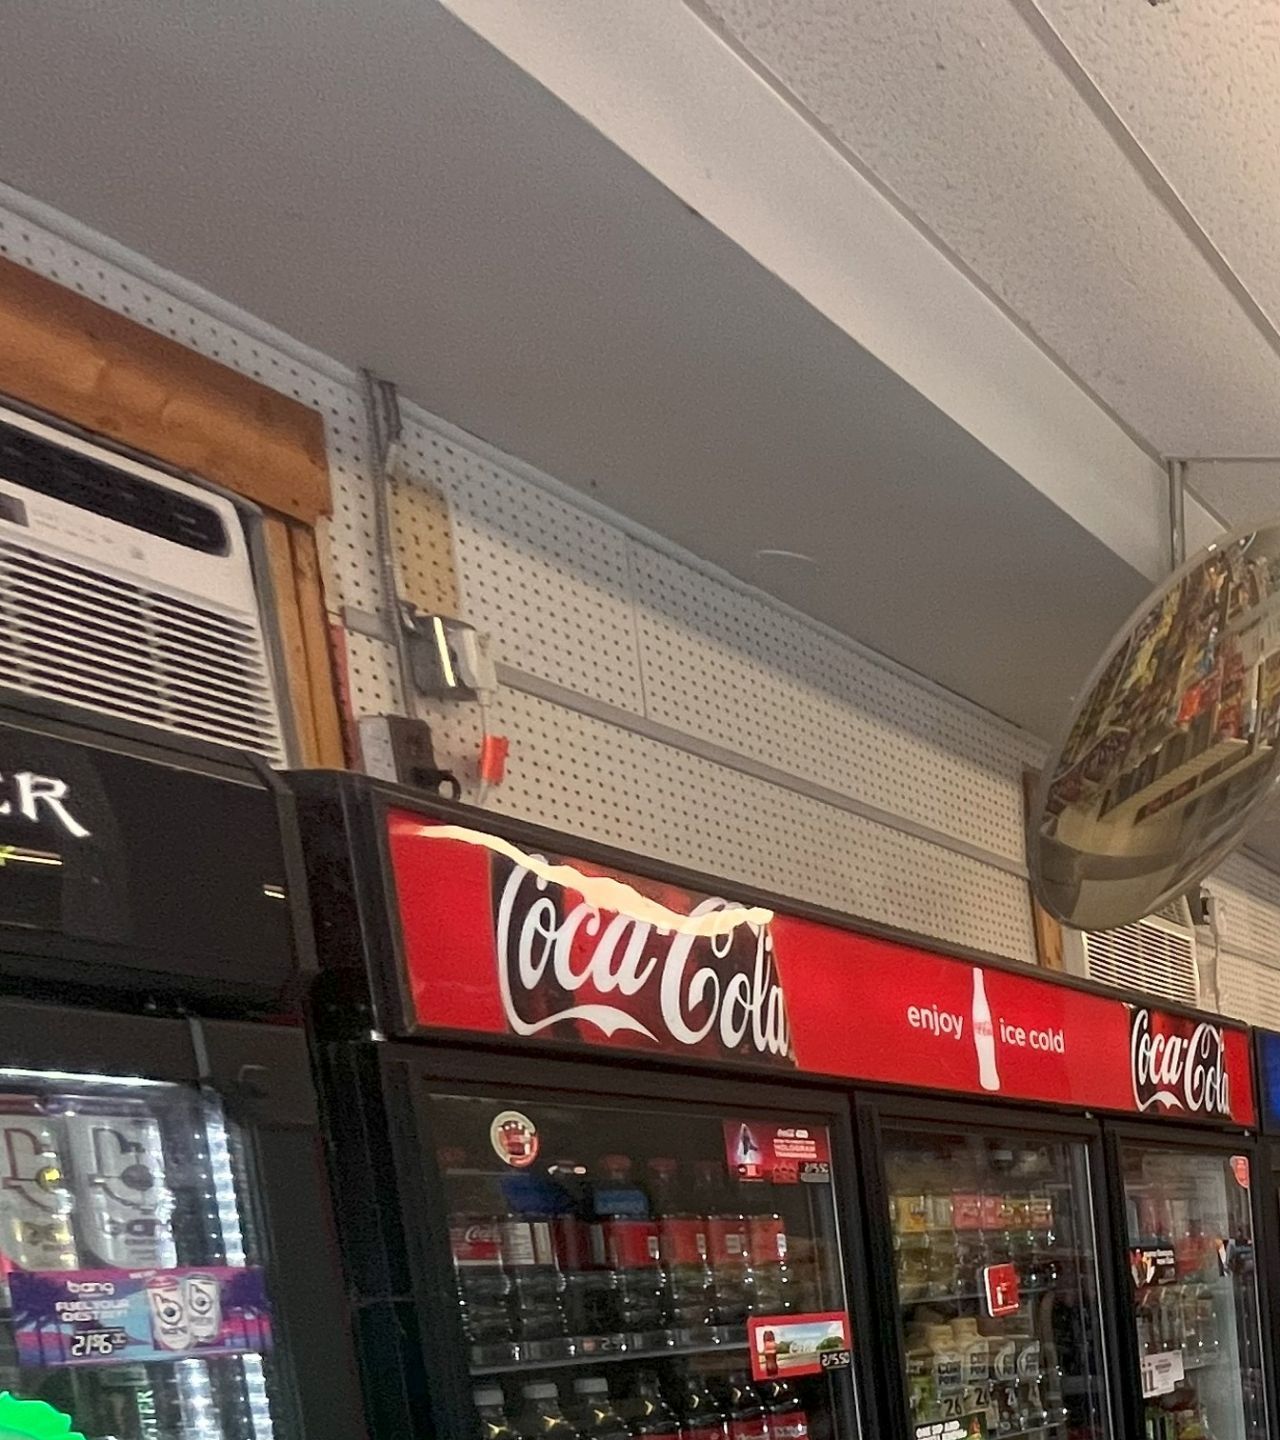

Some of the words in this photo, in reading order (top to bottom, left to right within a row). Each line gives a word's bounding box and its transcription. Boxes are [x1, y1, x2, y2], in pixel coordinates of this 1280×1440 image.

[907, 1005, 963, 1039] enjoy
[1000, 1018, 1025, 1046] ice
[1028, 1027, 1065, 1054] cold
[66, 1280, 115, 1295] bang
